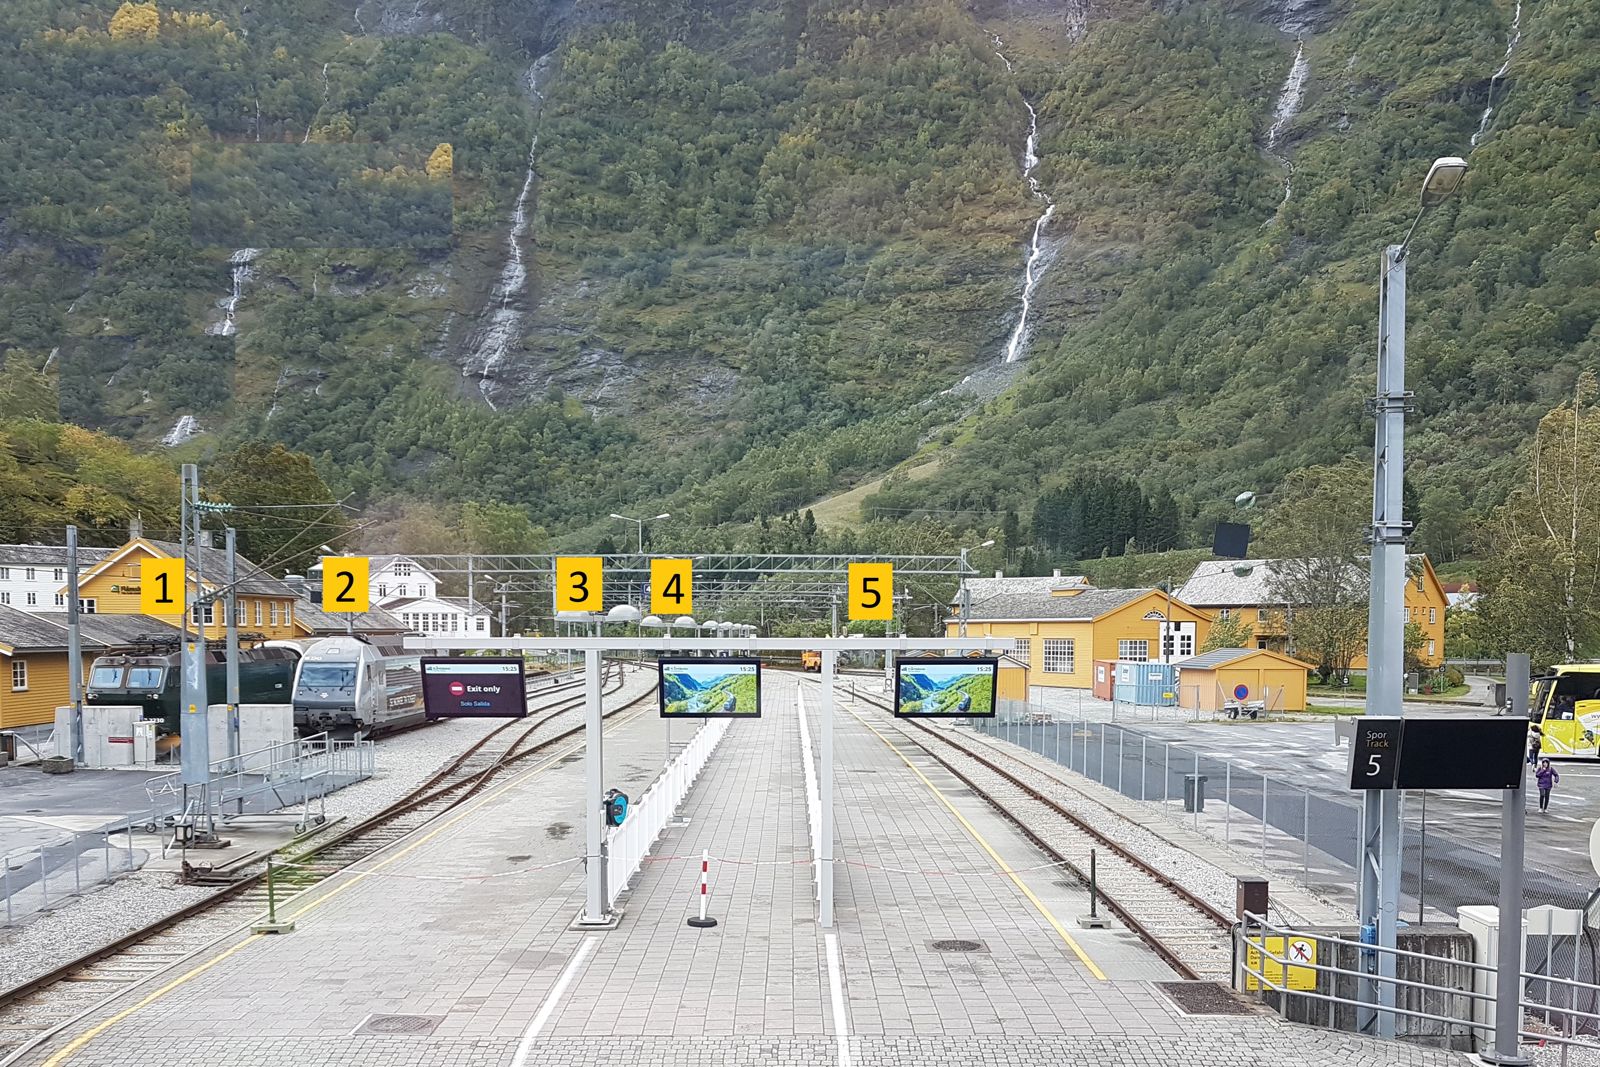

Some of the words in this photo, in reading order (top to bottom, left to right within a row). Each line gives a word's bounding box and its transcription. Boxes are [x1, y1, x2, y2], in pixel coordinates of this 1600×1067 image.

[466, 685, 482, 693] Exit
[483, 685, 501, 694] only
[1366, 730, 1387, 740] Spor
[1366, 740, 1389, 748] Track
[1366, 754, 1381, 776] 5
